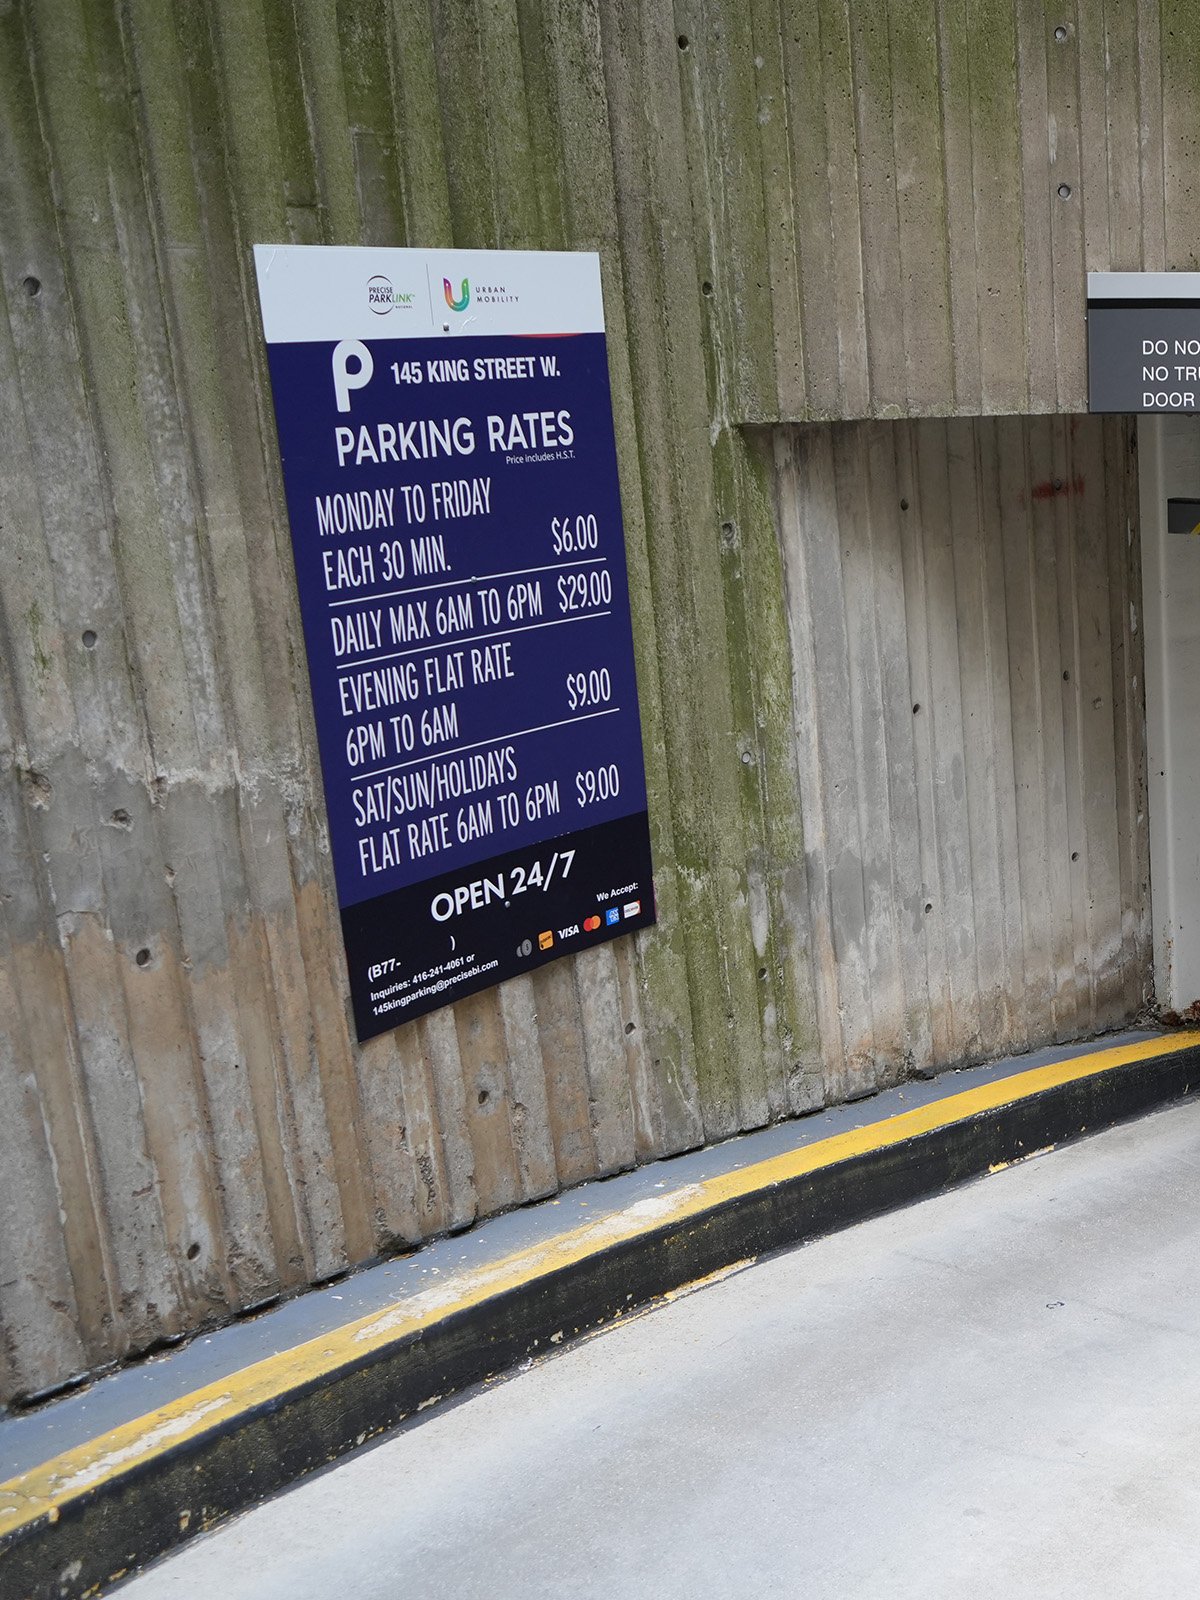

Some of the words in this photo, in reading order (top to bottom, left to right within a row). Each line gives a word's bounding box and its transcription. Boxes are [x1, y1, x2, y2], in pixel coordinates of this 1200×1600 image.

[391, 361, 423, 385] 145
[426, 359, 470, 384] KING
[473, 356, 536, 381] STREET
[540, 354, 561, 377] W.
[1142, 340, 1168, 355] DO
[1142, 366, 1169, 381] NO
[1142, 392, 1195, 408] DOOR
[334, 417, 475, 467] PARKING
[486, 409, 575, 452] RATES
[505, 453, 524, 465] Price
[525, 451, 555, 463] includes
[556, 450, 576, 460] H.S.T.
[316, 488, 394, 536] MONDAY
[401, 484, 426, 524] TO
[431, 477, 491, 520] FRIDAY
[551, 514, 598, 555] $6.00
[322, 545, 375, 591] EACH
[379, 540, 405, 581] 30
[410, 535, 451, 576] MIN.
[331, 609, 382, 657] DAILY
[389, 601, 431, 644] MAX
[435, 593, 474, 635] 6AM
[477, 588, 500, 625] TO
[506, 581, 543, 622] 6PM
[557, 569, 612, 613] $29.00
[338, 662, 419, 717] EVENING
[424, 652, 464, 695] FLAT
[471, 642, 515, 685] RATE
[566, 668, 611, 711] $9.00
[346, 721, 386, 766] 6PM
[390, 714, 415, 754] TO
[421, 702, 459, 746] 6AM
[351, 746, 518, 827] SAT/SUN/HOLIDAYS
[359, 828, 401, 877] FLAT
[408, 813, 452, 860] RATE
[457, 800, 494, 843] 6AM
[497, 793, 519, 829] TO
[525, 780, 560, 822] 6PM
[575, 764, 620, 808] $9.00
[431, 873, 505, 922] OPEN
[510, 849, 576, 895] 24/7
[596, 892, 609, 902] We
[610, 882, 639, 898] Accept:
[557, 924, 580, 939] VISA
[370, 979, 411, 1001] Inquiries:
[412, 957, 464, 984] 416-241-4061
[466, 953, 475, 962] or
[373, 959, 499, 1015] 145kingparking@precisebi.com
